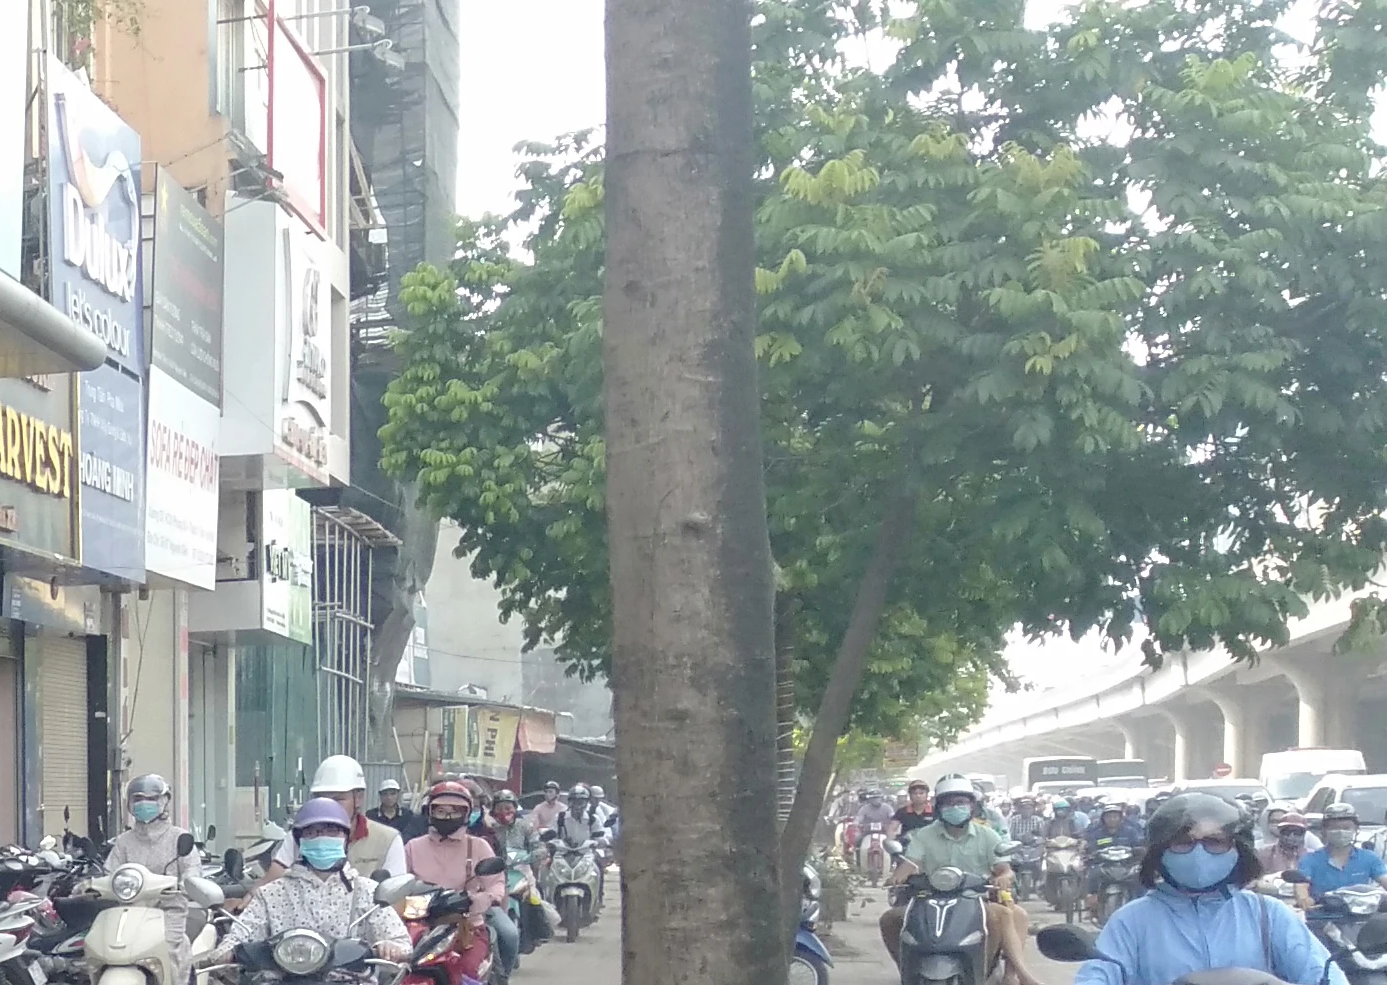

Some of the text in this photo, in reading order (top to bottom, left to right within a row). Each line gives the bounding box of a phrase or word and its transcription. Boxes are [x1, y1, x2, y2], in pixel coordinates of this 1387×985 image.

[63, 182, 131, 302] Dulux
[94, 308, 130, 357] colour
[151, 419, 172, 473] SOFA
[113, 464, 134, 502] MINH
